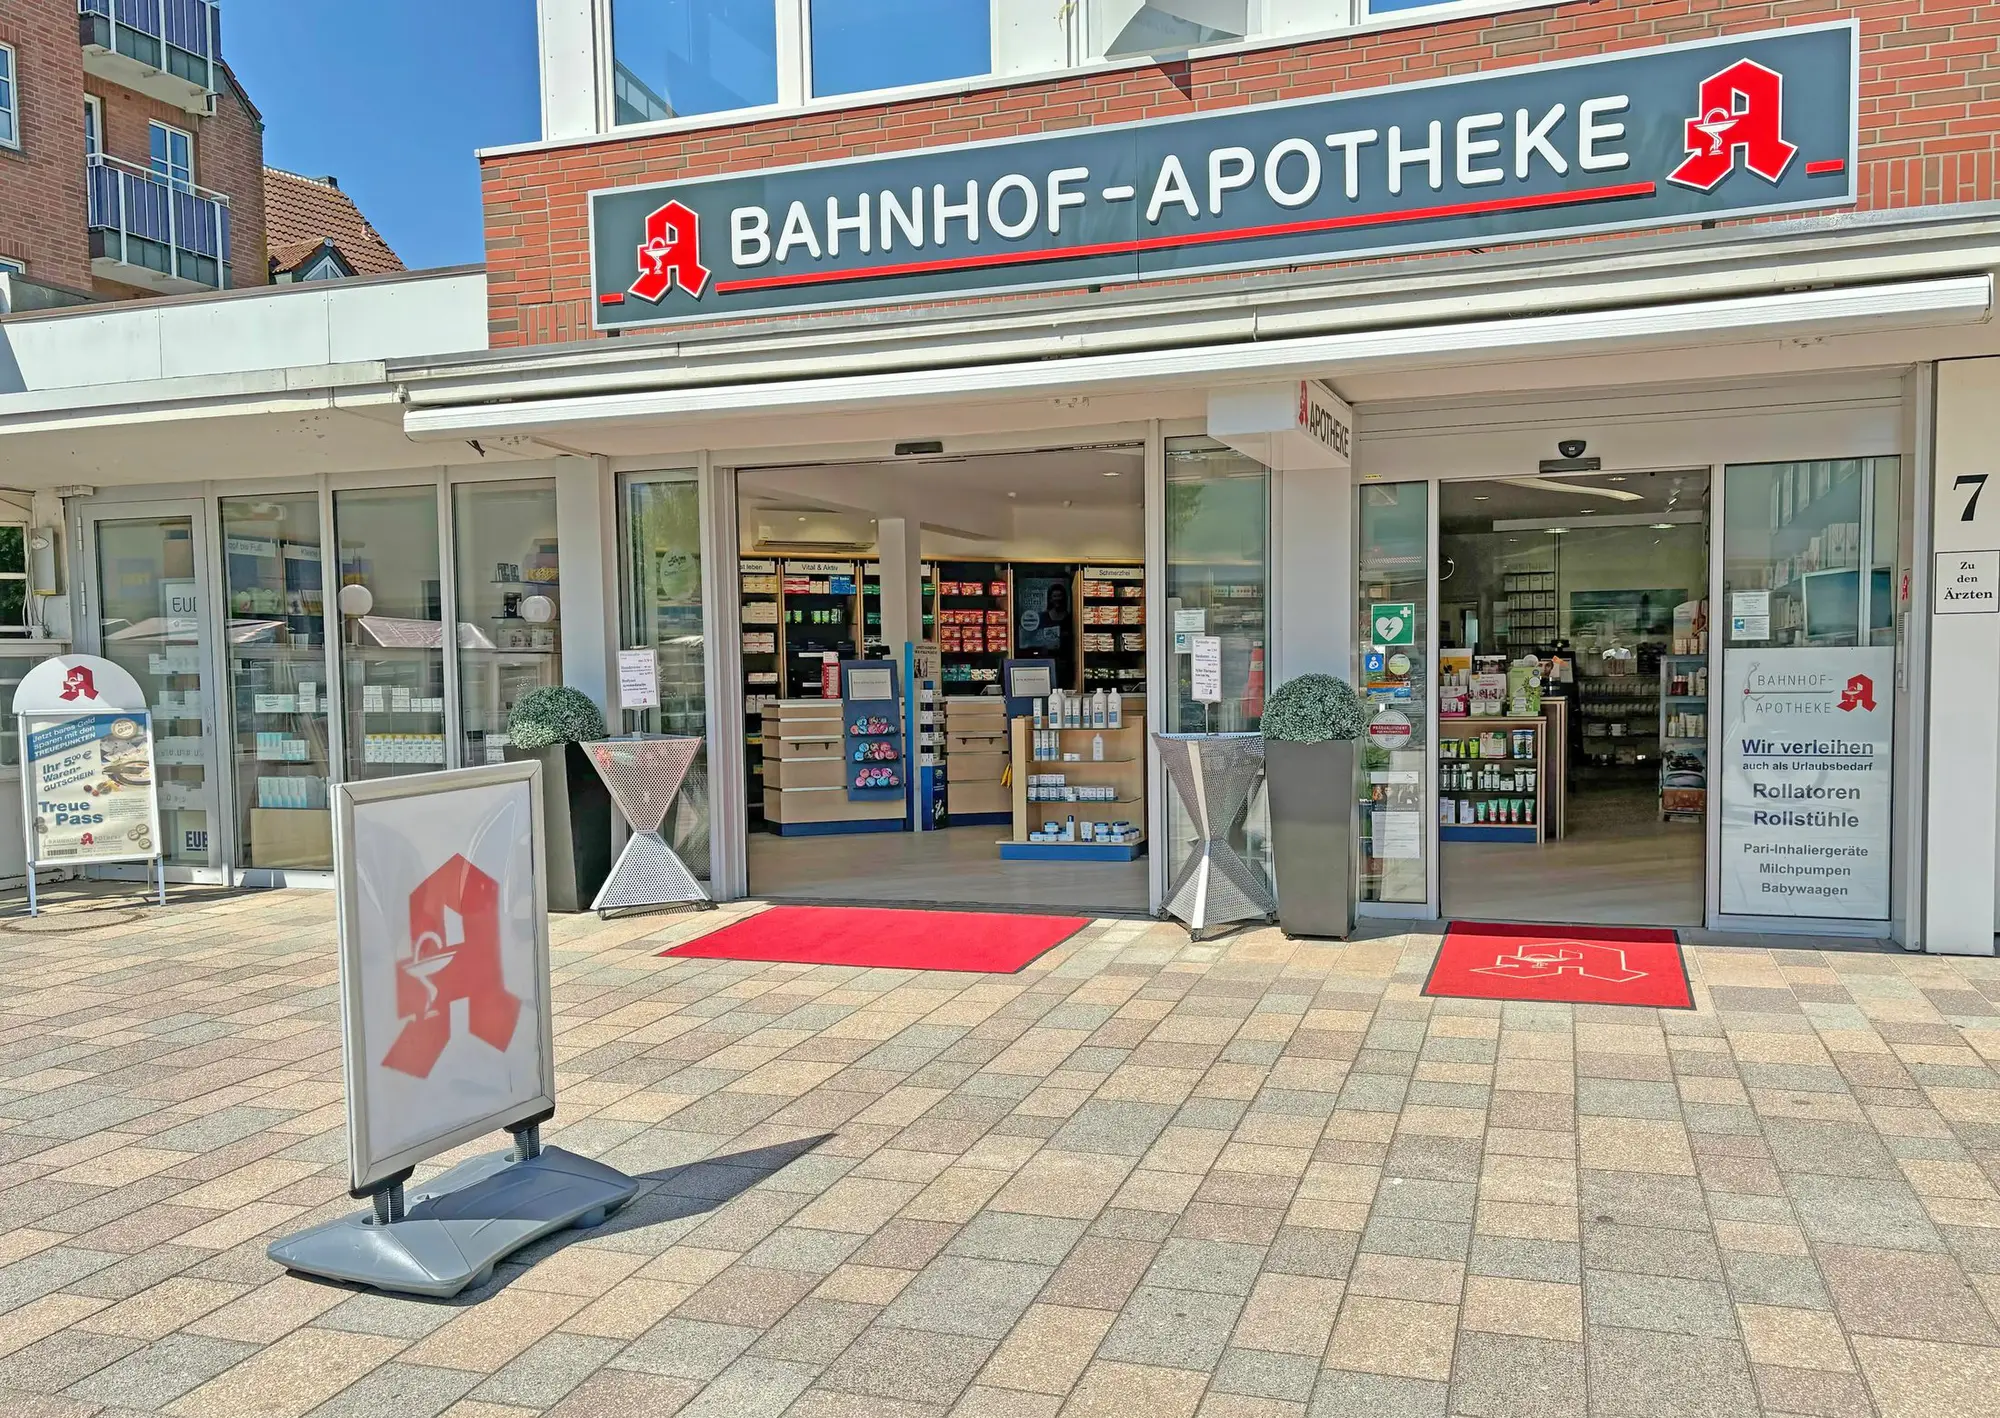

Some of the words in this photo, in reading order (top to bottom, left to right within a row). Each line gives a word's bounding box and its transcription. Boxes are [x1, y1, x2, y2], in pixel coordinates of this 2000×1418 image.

[1309, 400, 1349, 459] APOTHEKE
[1952, 473, 1989, 522] 7
[746, 563, 763, 571] leben
[801, 563, 816, 571] Vital
[816, 563, 822, 571] &
[823, 563, 838, 572] Aktiv
[1960, 561, 1975, 570] Zu
[1099, 569, 1131, 577] Schmerzfrei
[1956, 574, 1978, 583] den
[1944, 587, 1993, 600] Ärzten
[172, 596, 197, 612] EU
[1757, 674, 1833, 686] BAHNHOF-
[1755, 702, 1831, 714] APOTHEKE
[33, 731, 52, 743] Jetzt
[54, 725, 76, 736] bares
[77, 717, 96, 728] Geld
[34, 736, 63, 750] sparen
[64, 730, 78, 740] mit
[79, 726, 96, 735] den
[34, 733, 96, 758] TREUEPUNKTEN
[1742, 739, 1774, 754] Wir
[1781, 739, 1874, 755] verleihen
[42, 761, 61, 775] Ihr
[1742, 760, 1769, 771] auch
[1772, 761, 1789, 771] als
[1792, 761, 1873, 771] Urlaubsbedarf
[42, 766, 81, 783] Waren-
[1753, 783, 1860, 800] Rollatoren
[38, 801, 91, 813] Treue
[55, 812, 104, 826] Pass
[1754, 810, 1859, 827] Rollstühle
[1743, 843, 1868, 858] Pari-Inhaliergeräte
[1759, 863, 1851, 877] Milchpumpen
[1761, 882, 1848, 897] Babywaagen
